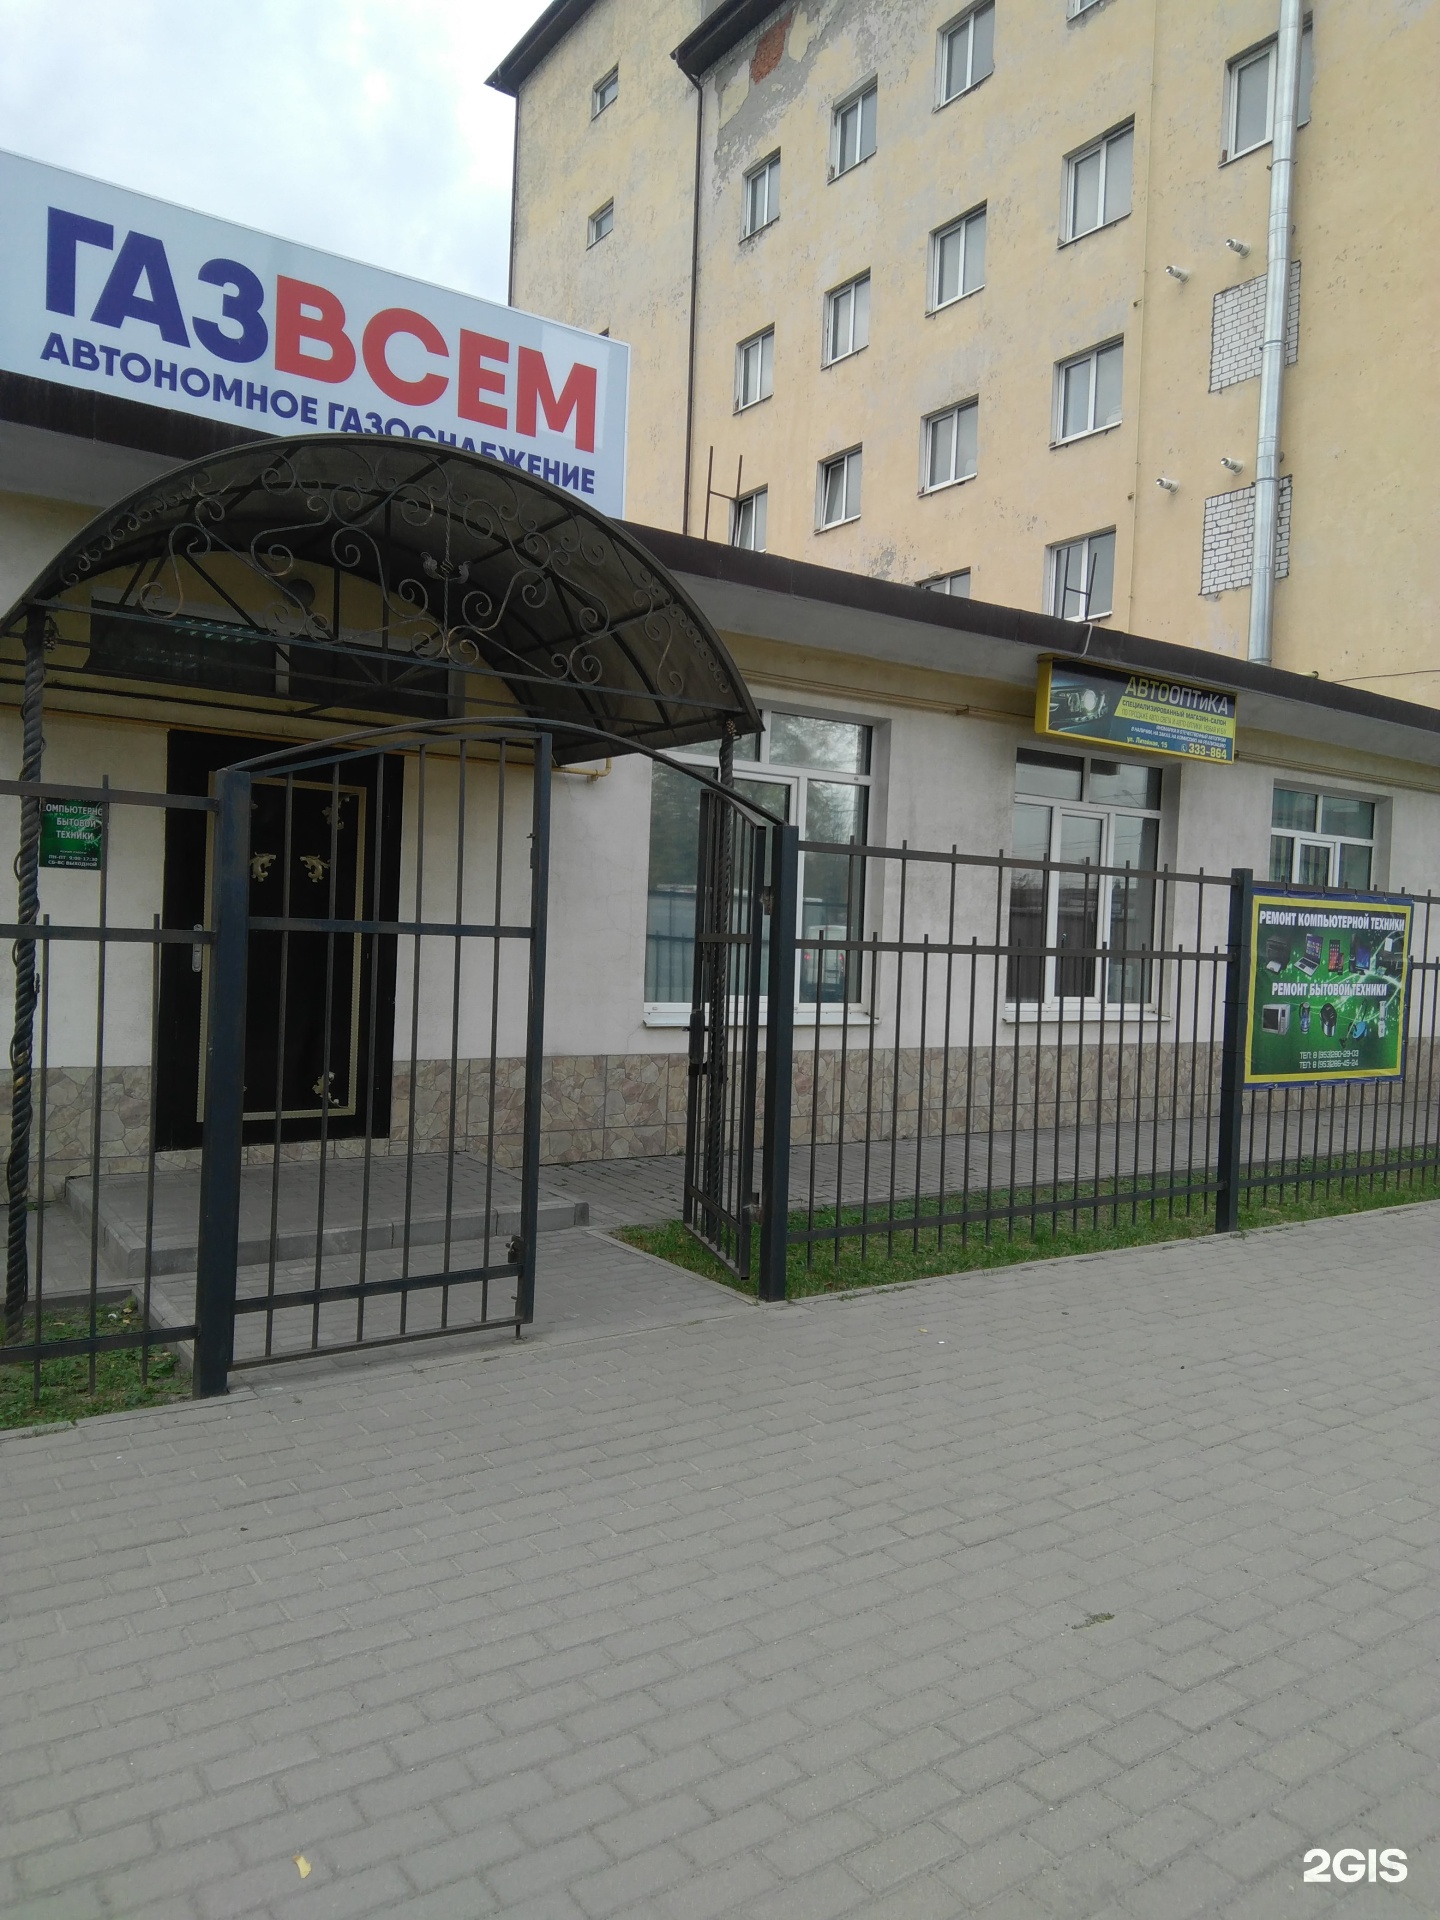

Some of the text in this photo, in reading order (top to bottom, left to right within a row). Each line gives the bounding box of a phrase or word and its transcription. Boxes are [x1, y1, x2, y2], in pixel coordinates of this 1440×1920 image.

[40, 332, 318, 425] АВТОНОМНОЕ
[1122, 700, 1226, 725] СПЕЦИАЛИЗИРОВАННЫЙ МАГАЗИН-САЛОН
[1189, 743, 1227, 759] 333-864
[56, 829, 94, 840] ТЕХНИКИ
[1259, 911, 1405, 931] РЕМОНТ КОМПЬЮТЕРНОЙ ТЕХНИКИ
[1271, 980, 1387, 997] РЕМОНТ БЫТОВОЙ ТЕХНИКИ
